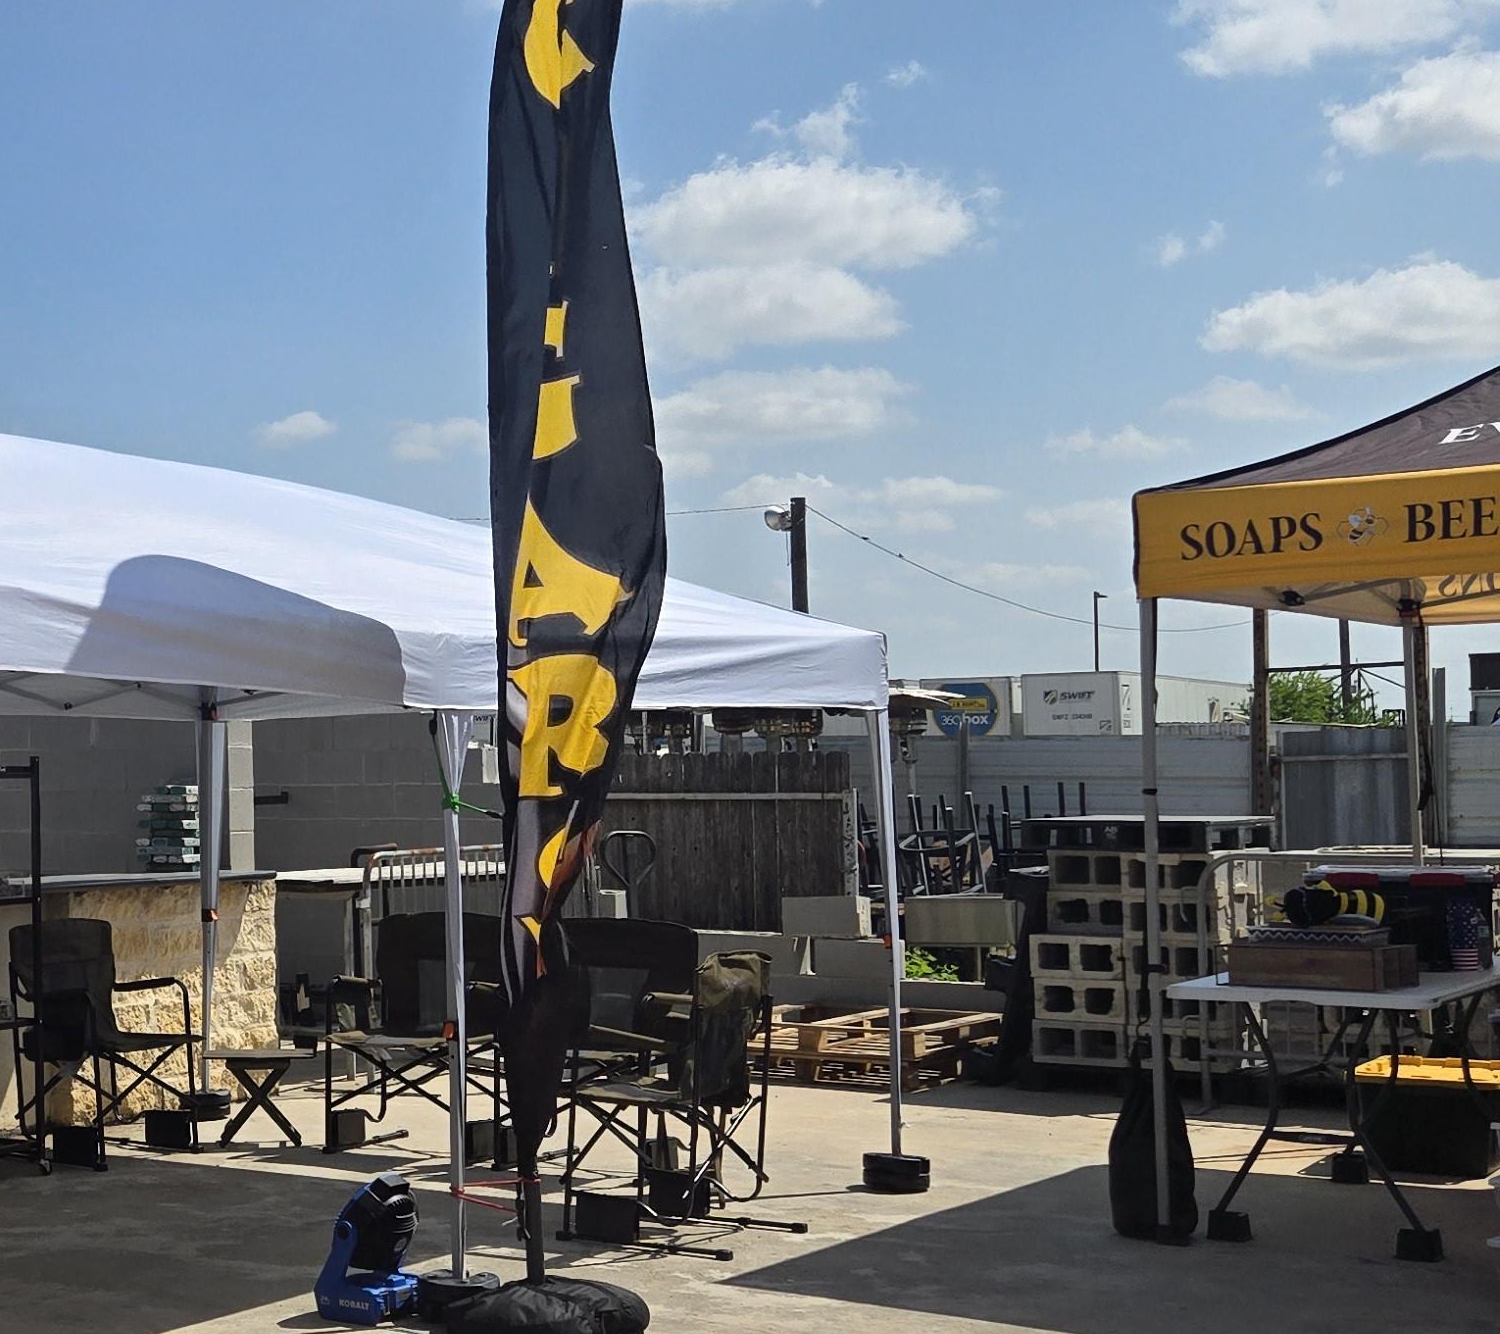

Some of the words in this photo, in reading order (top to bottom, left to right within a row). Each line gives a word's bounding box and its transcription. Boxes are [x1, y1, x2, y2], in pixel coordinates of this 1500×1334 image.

[1179, 512, 1324, 561] SOAPS
[1060, 690, 1095, 700] SWIFT
[339, 1298, 369, 1311] KOBALT
